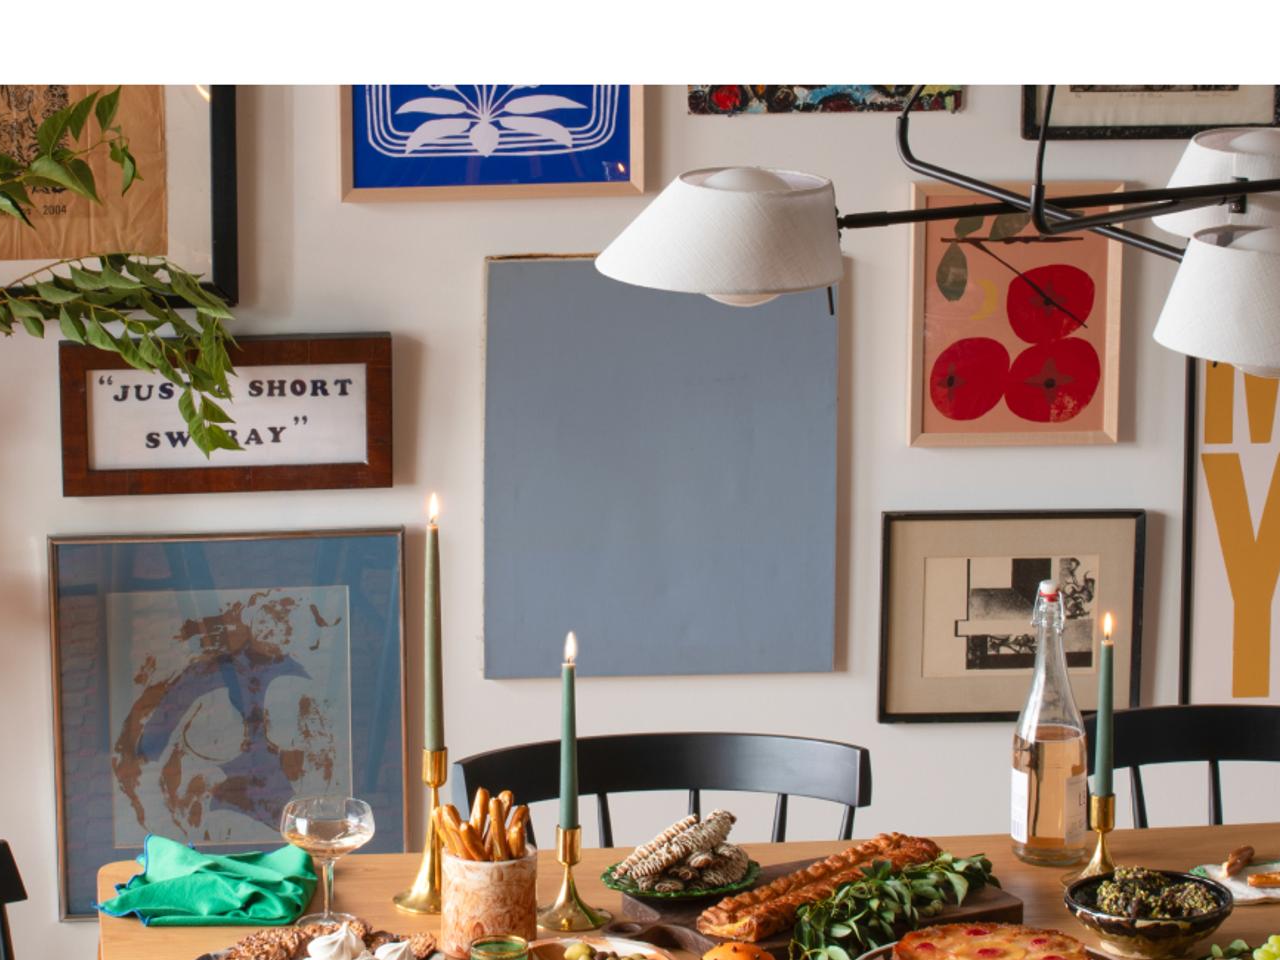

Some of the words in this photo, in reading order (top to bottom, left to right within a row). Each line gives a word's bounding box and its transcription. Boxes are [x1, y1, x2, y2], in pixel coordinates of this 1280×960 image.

[42, 204, 66, 216] 2004
[98, 375, 193, 402] “JUS
[248, 378, 352, 398] SHORT
